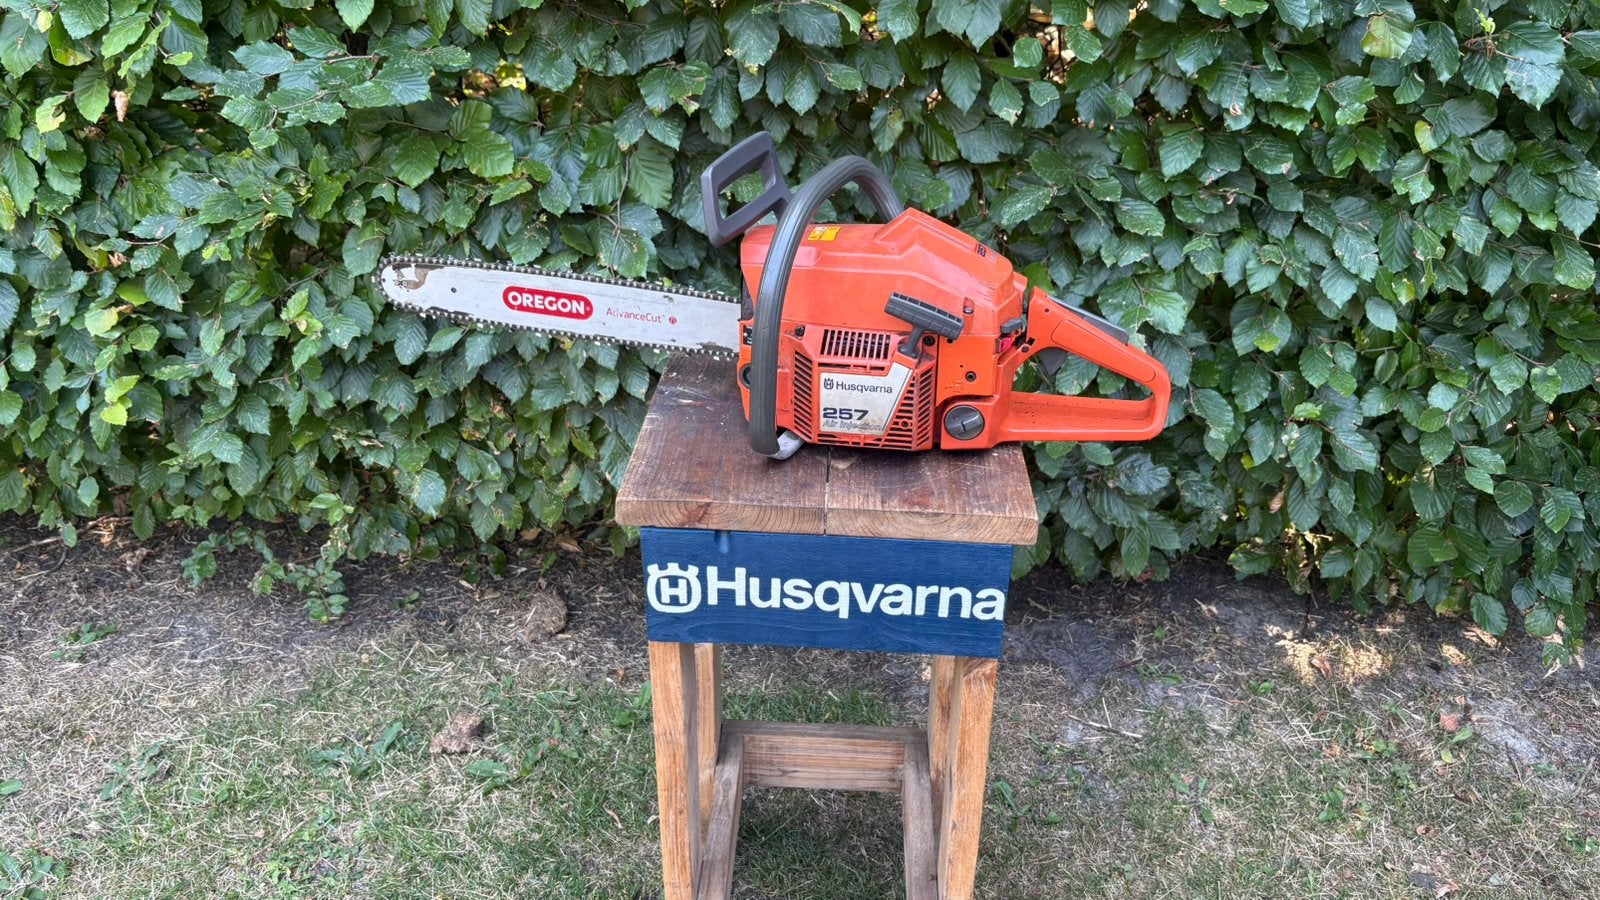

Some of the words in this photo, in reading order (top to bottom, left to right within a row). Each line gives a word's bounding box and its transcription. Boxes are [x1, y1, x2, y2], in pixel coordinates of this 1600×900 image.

[508, 291, 585, 314] OREGON
[836, 381, 892, 393] Husqvarna
[823, 407, 868, 420] 257
[823, 420, 838, 428] Air
[706, 566, 1005, 620] Husqvarna
